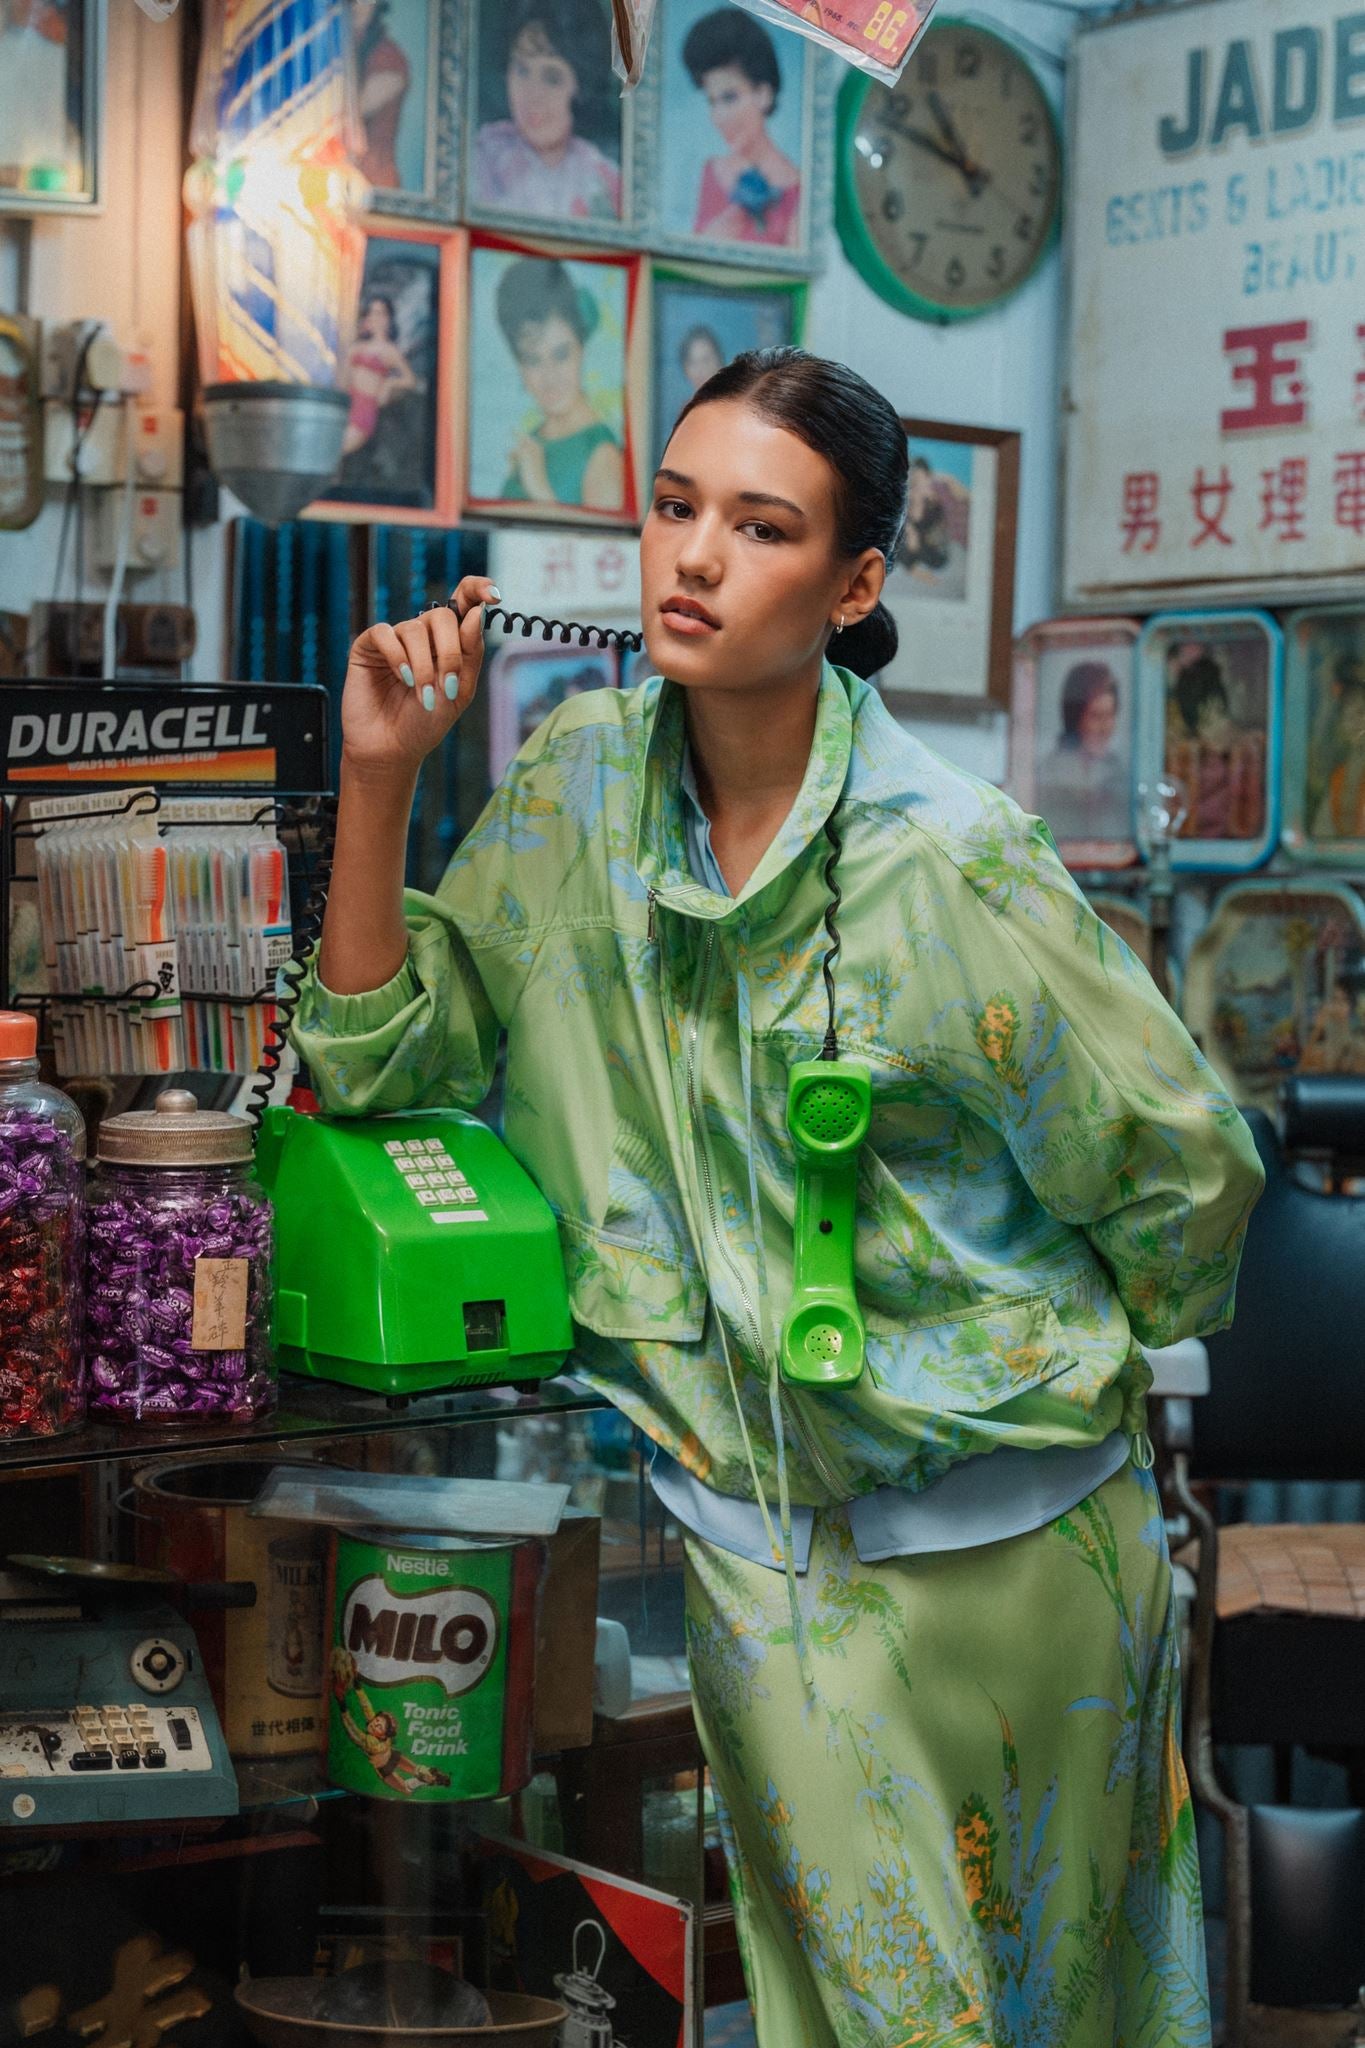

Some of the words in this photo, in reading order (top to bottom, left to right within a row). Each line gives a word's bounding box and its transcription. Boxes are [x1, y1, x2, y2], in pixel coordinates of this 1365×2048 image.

[7, 703, 268, 758] DURACELL
[348, 1603, 489, 1665] MILO
[402, 1701, 460, 1721] Tonic
[407, 1721, 462, 1738] Food
[411, 1738, 469, 1756] Drink
